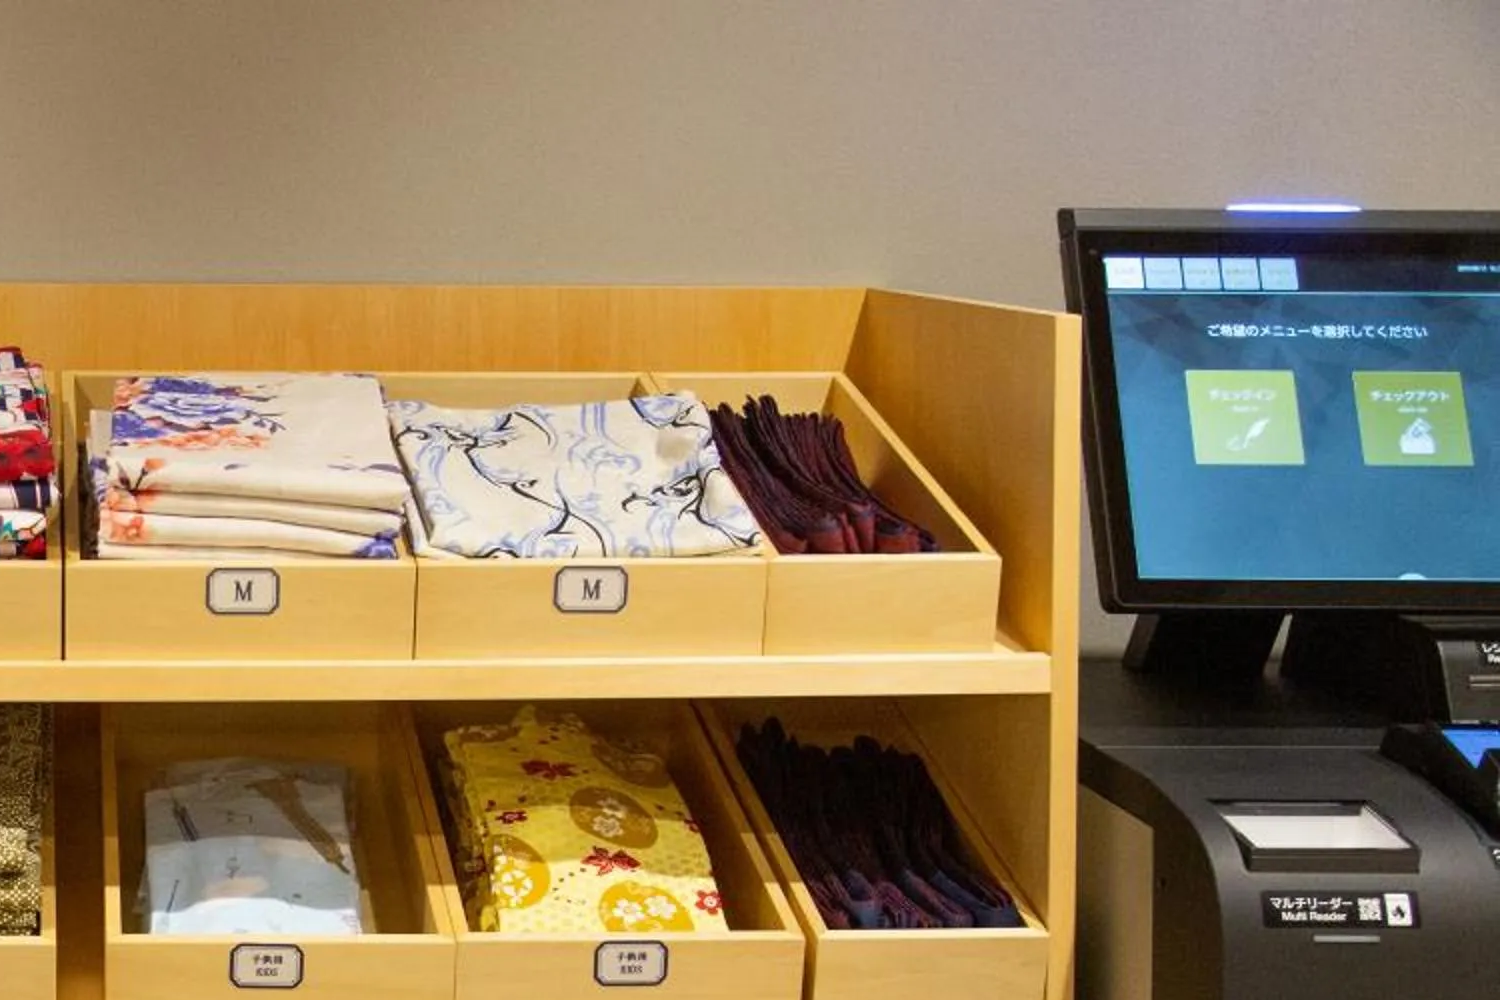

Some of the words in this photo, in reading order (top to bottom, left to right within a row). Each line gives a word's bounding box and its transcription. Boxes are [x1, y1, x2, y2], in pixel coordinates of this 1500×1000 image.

[1207, 323, 1429, 339] ご希望のメニューを選択してください
[1370, 389, 1451, 402] チェックアウト
[234, 580, 253, 602] M
[582, 578, 602, 601] M
[1269, 897, 1353, 910] マルチリーダー
[1281, 911, 1308, 921] Multi
[1309, 911, 1347, 921] Reader
[255, 967, 279, 977] KIDS
[619, 964, 643, 975] KIDS
